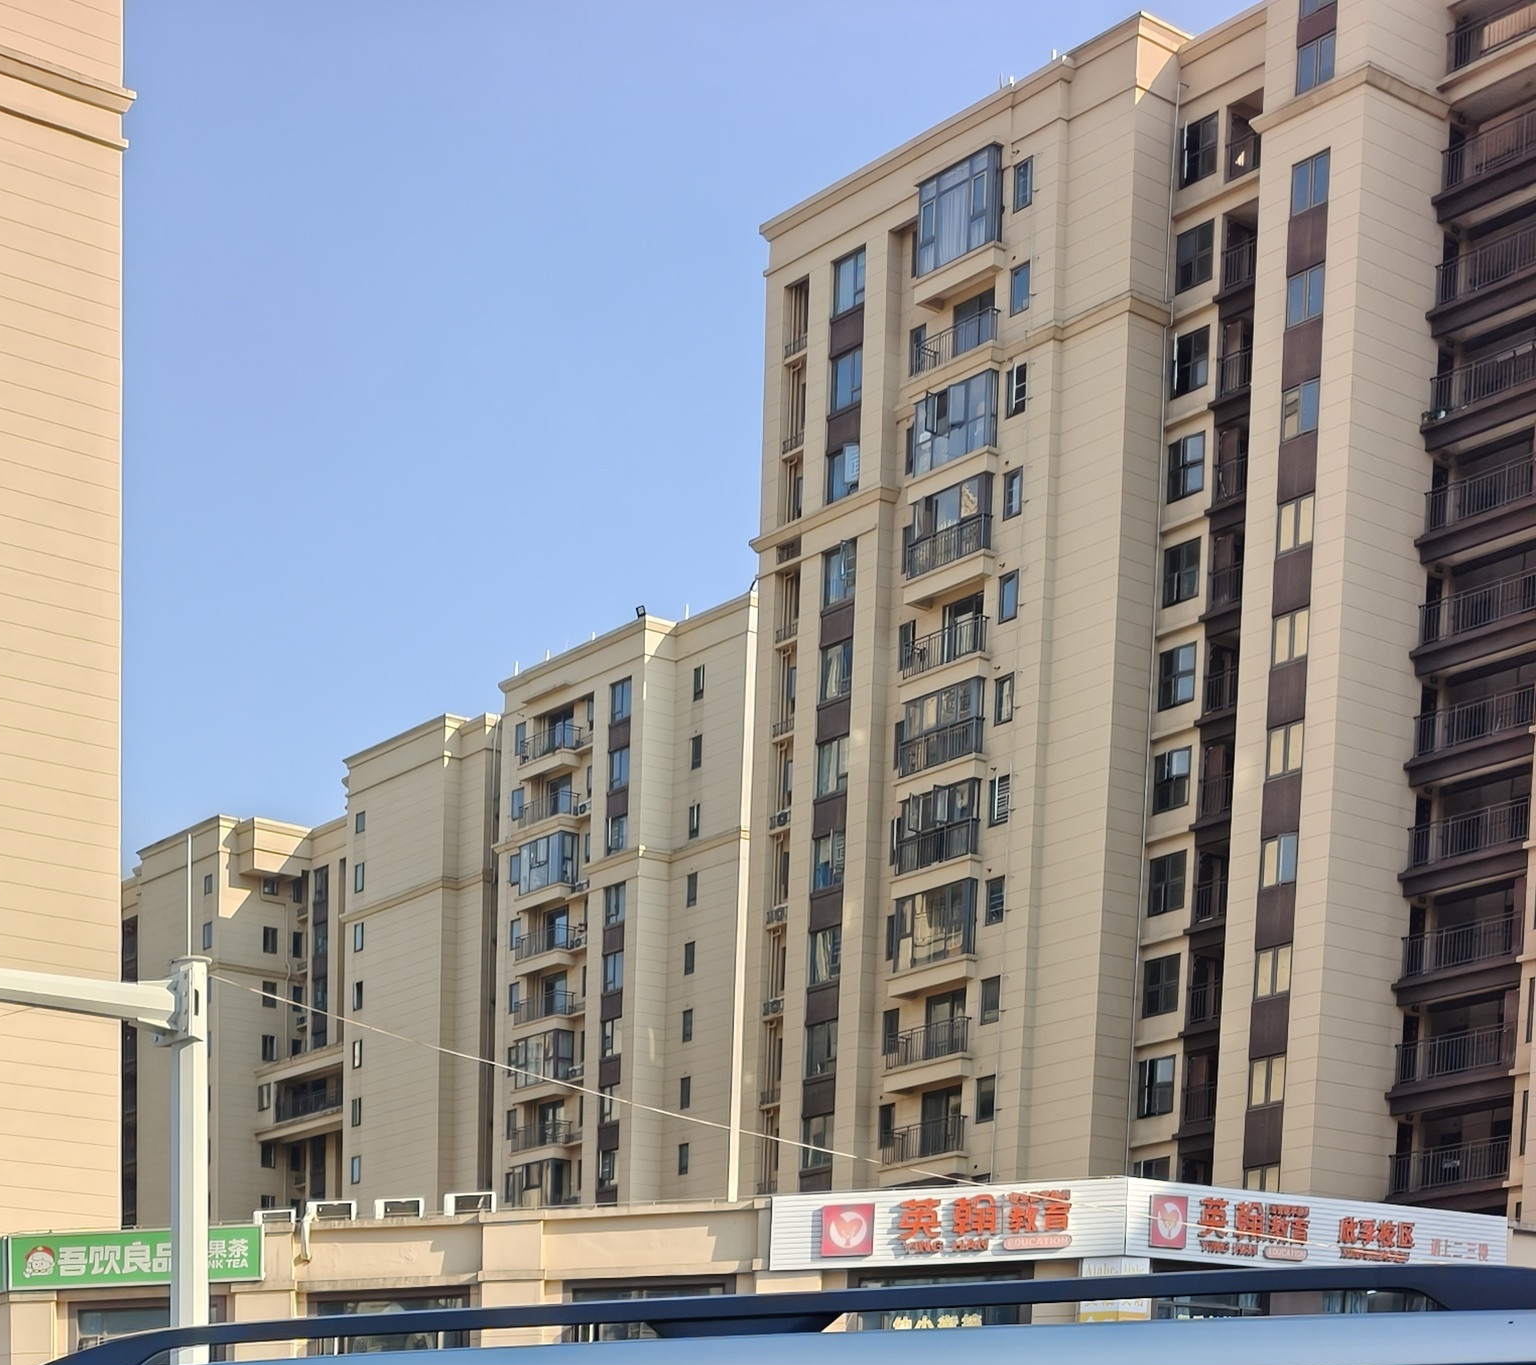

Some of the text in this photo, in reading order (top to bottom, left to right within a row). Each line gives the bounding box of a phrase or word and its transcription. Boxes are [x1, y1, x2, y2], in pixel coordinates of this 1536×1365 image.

[208, 1238, 249, 1258] 果茶
[1007, 1236, 1068, 1248] EDUCATION
[57, 1241, 171, 1277] 吾饮良品
[226, 1258, 249, 1269] TEA
